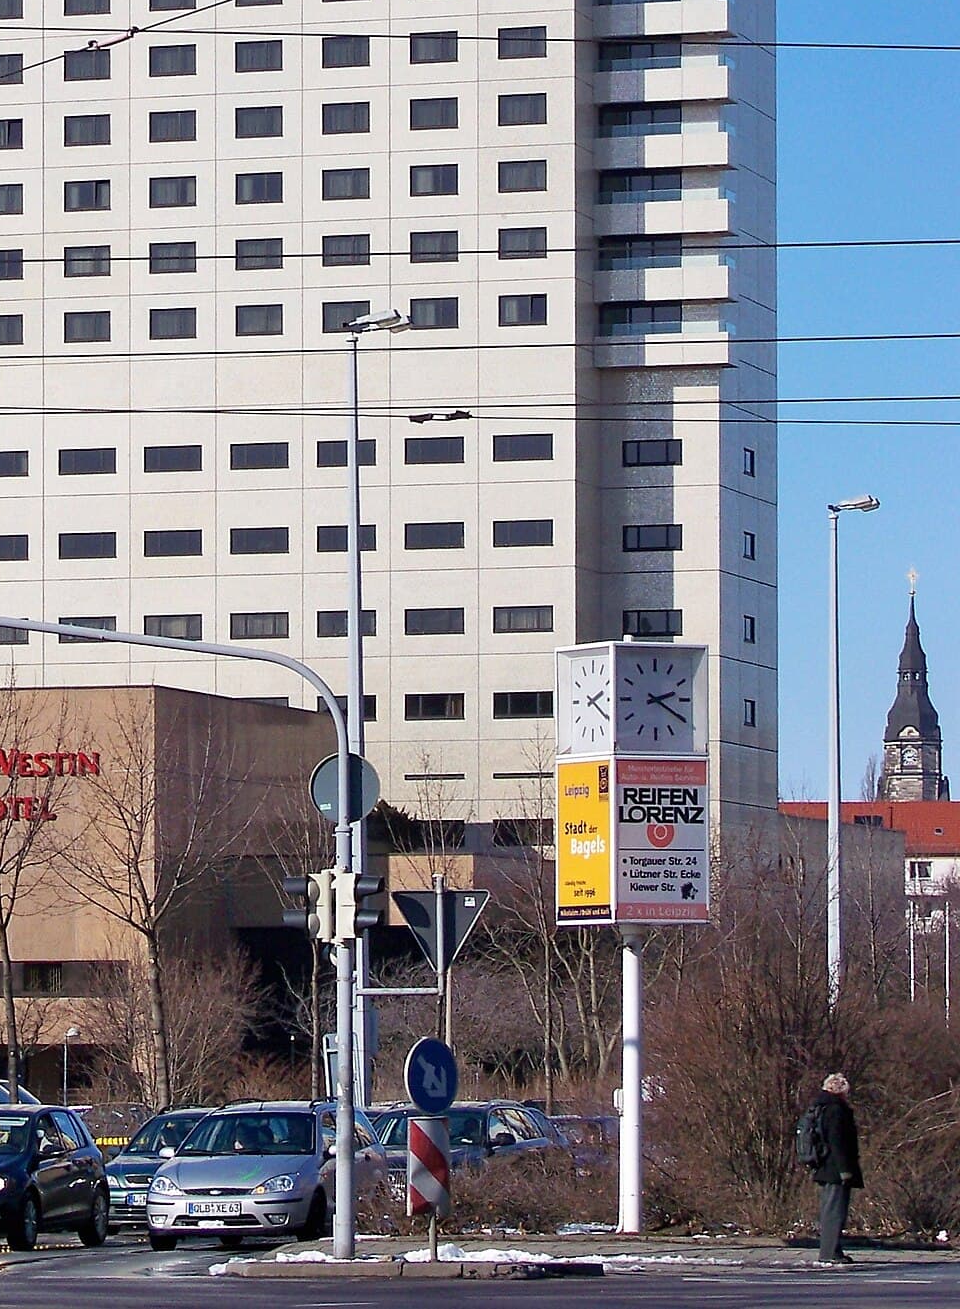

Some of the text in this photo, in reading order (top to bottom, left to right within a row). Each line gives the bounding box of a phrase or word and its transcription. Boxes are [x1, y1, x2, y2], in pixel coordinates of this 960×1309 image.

[564, 783, 590, 800] Leipzig
[623, 787, 698, 805] REIFEN
[619, 806, 704, 824] LORENZ
[565, 820, 598, 835] Stadt der
[570, 835, 606, 860] Bagels
[629, 856, 698, 867] Torgauer Str. 24
[629, 869, 701, 879] Lützner Str. Ecke
[629, 882, 676, 892] Kiewer Str.
[626, 905, 633, 916] 2
[645, 906, 656, 917] in
[216, 1204, 227, 1213] XE
[229, 1203, 240, 1213] 63
